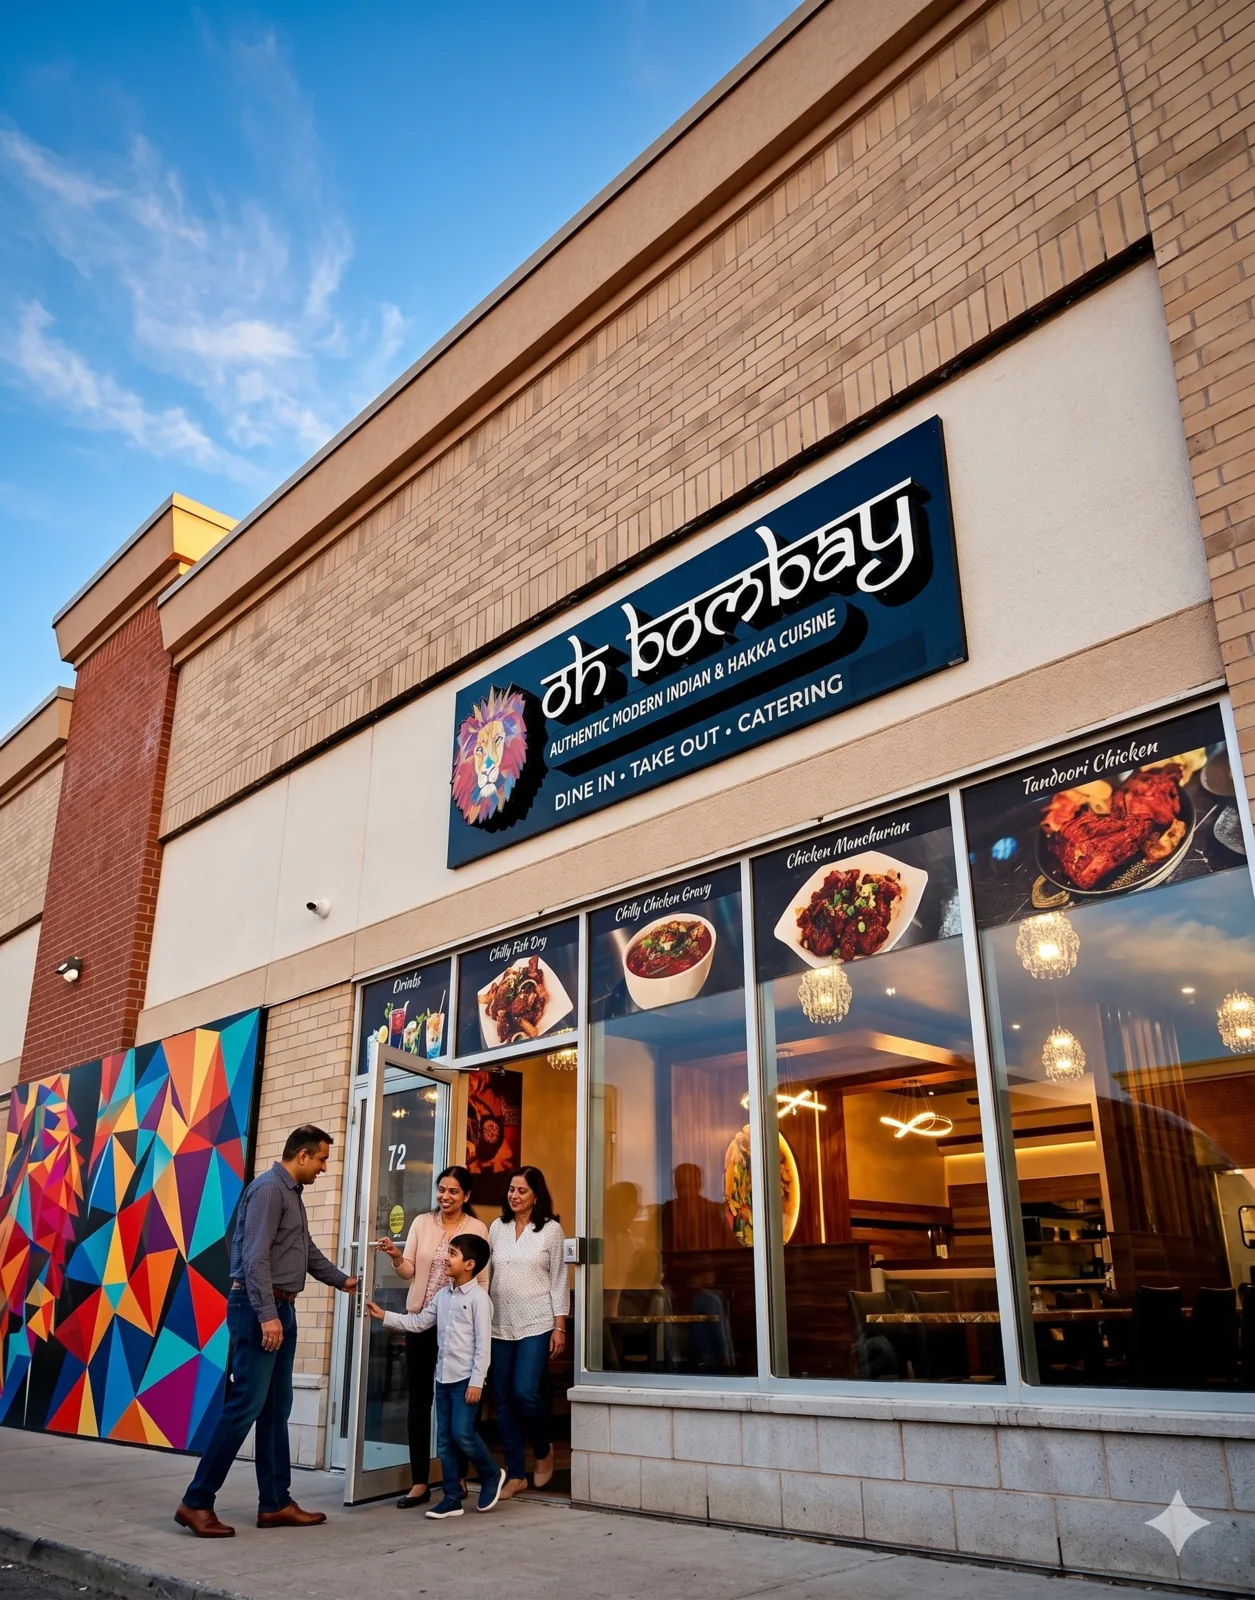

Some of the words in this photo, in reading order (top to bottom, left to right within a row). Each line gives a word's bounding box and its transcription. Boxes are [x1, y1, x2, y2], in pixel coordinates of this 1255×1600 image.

[541, 635, 609, 718] oh
[622, 475, 916, 678] bombay
[549, 717, 610, 758] AUTHENTIC
[612, 691, 664, 728] MODERN
[666, 668, 711, 702] INDIAN
[714, 663, 726, 680] &
[727, 637, 777, 675] HAKKA
[778, 608, 837, 649] CUISINE
[554, 781, 594, 811] DINE
[598, 771, 616, 793] IN
[630, 745, 675, 778] TAKE
[680, 726, 720, 757] OUT
[737, 673, 844, 734] CATERING
[1022, 760, 1089, 795] Tandoori
[1093, 741, 1159, 773] Chicken
[786, 845, 831, 869] Chicken
[833, 822, 911, 855] Manchurian
[615, 901, 641, 922] Chilly
[643, 892, 680, 914] Chicken
[682, 883, 712, 902] Gravy
[489, 943, 511, 962] Chilly
[512, 937, 529, 956] Fish
[530, 935, 547, 952] Dry
[388, 1143, 407, 1171] 72
